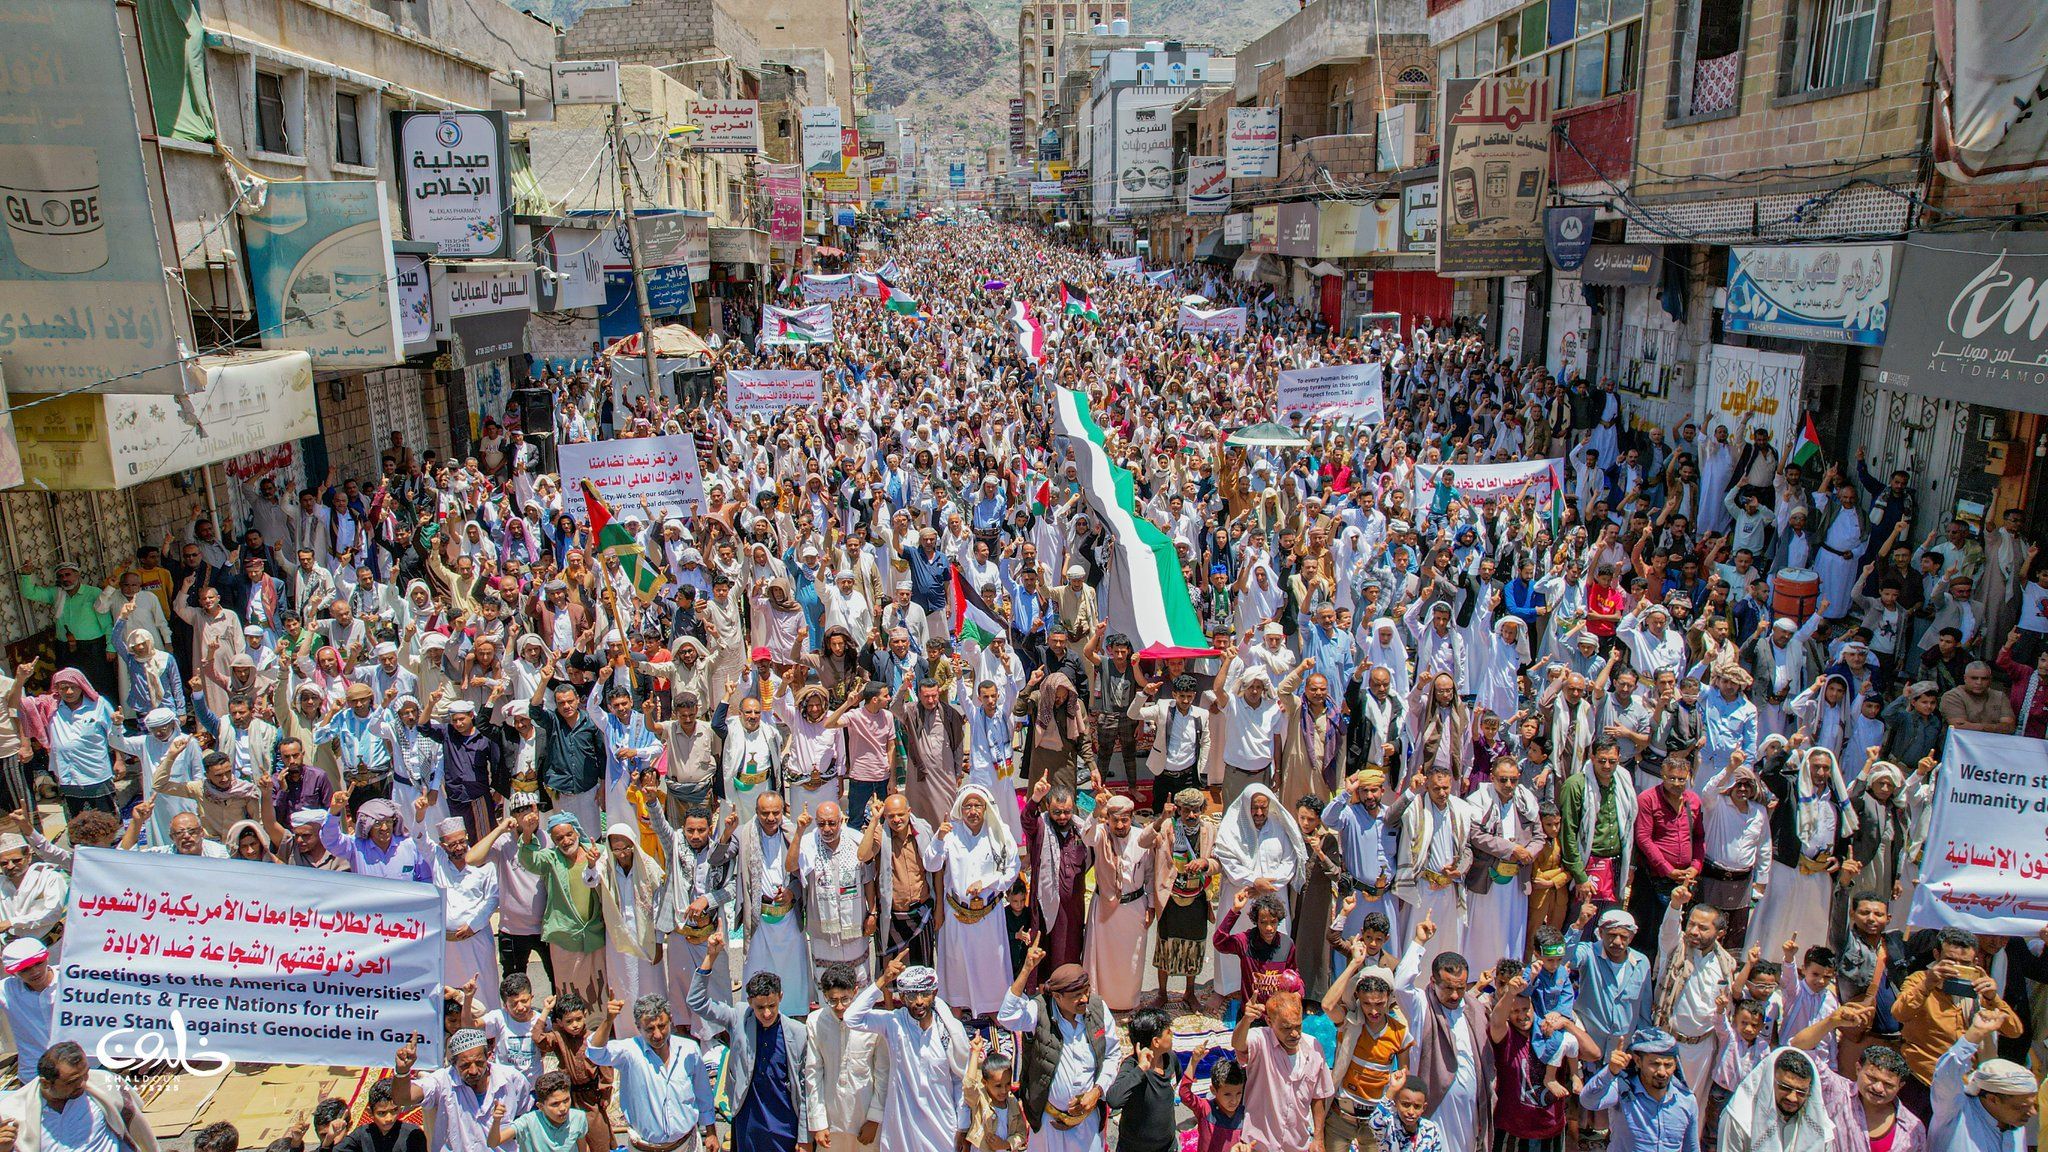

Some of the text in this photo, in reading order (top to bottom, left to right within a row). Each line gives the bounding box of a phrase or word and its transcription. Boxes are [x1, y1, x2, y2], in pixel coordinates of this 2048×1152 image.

[557, 62, 610, 78] الشعيبي
[691, 101, 753, 118] صيدلية
[1450, 79, 1549, 131] الملك
[710, 120, 753, 133] العربي
[1125, 123, 1167, 134] الشرعبي
[1484, 133, 1514, 145] الهاتف
[1516, 135, 1547, 152] لخدمات
[413, 150, 490, 173] صيدلية
[416, 177, 491, 200] الإخلاص
[491, 270, 528, 306] الشرق
[1931, 341, 1988, 363] موبايل
[1928, 360, 2048, 385] AL TDHAMO
[757, 379, 791, 389] الجماعية
[792, 379, 816, 388] المقابر
[1310, 383, 1331, 391] tyranny
[793, 391, 815, 401] شهادة
[588, 451, 678, 470] من تعز نبعث تضامننا
[594, 474, 625, 488] الداعم
[627, 472, 655, 489] العالمي
[655, 470, 684, 485] الحراك
[684, 471, 694, 485] مع
[1476, 477, 1501, 488] العالم
[658, 489, 685, 497] solidarity
[1960, 764, 2048, 789] Western st
[1950, 788, 2048, 814] humanity d
[1944, 840, 2017, 876] الإنسانية
[78, 887, 427, 943] التحية لطلاب الجامعات الأمريكية والشعوب
[101, 928, 392, 978] الحرة لوقفتهم الشجاعة ضد الابادة
[65, 963, 426, 1003] Greetings to the America Universities'
[62, 987, 380, 1022] Students & Free Nations for their
[60, 1010, 118, 1029] Brave
[186, 1017, 258, 1038] against
[262, 1021, 352, 1041] Genocide
[356, 1025, 374, 1041] in
